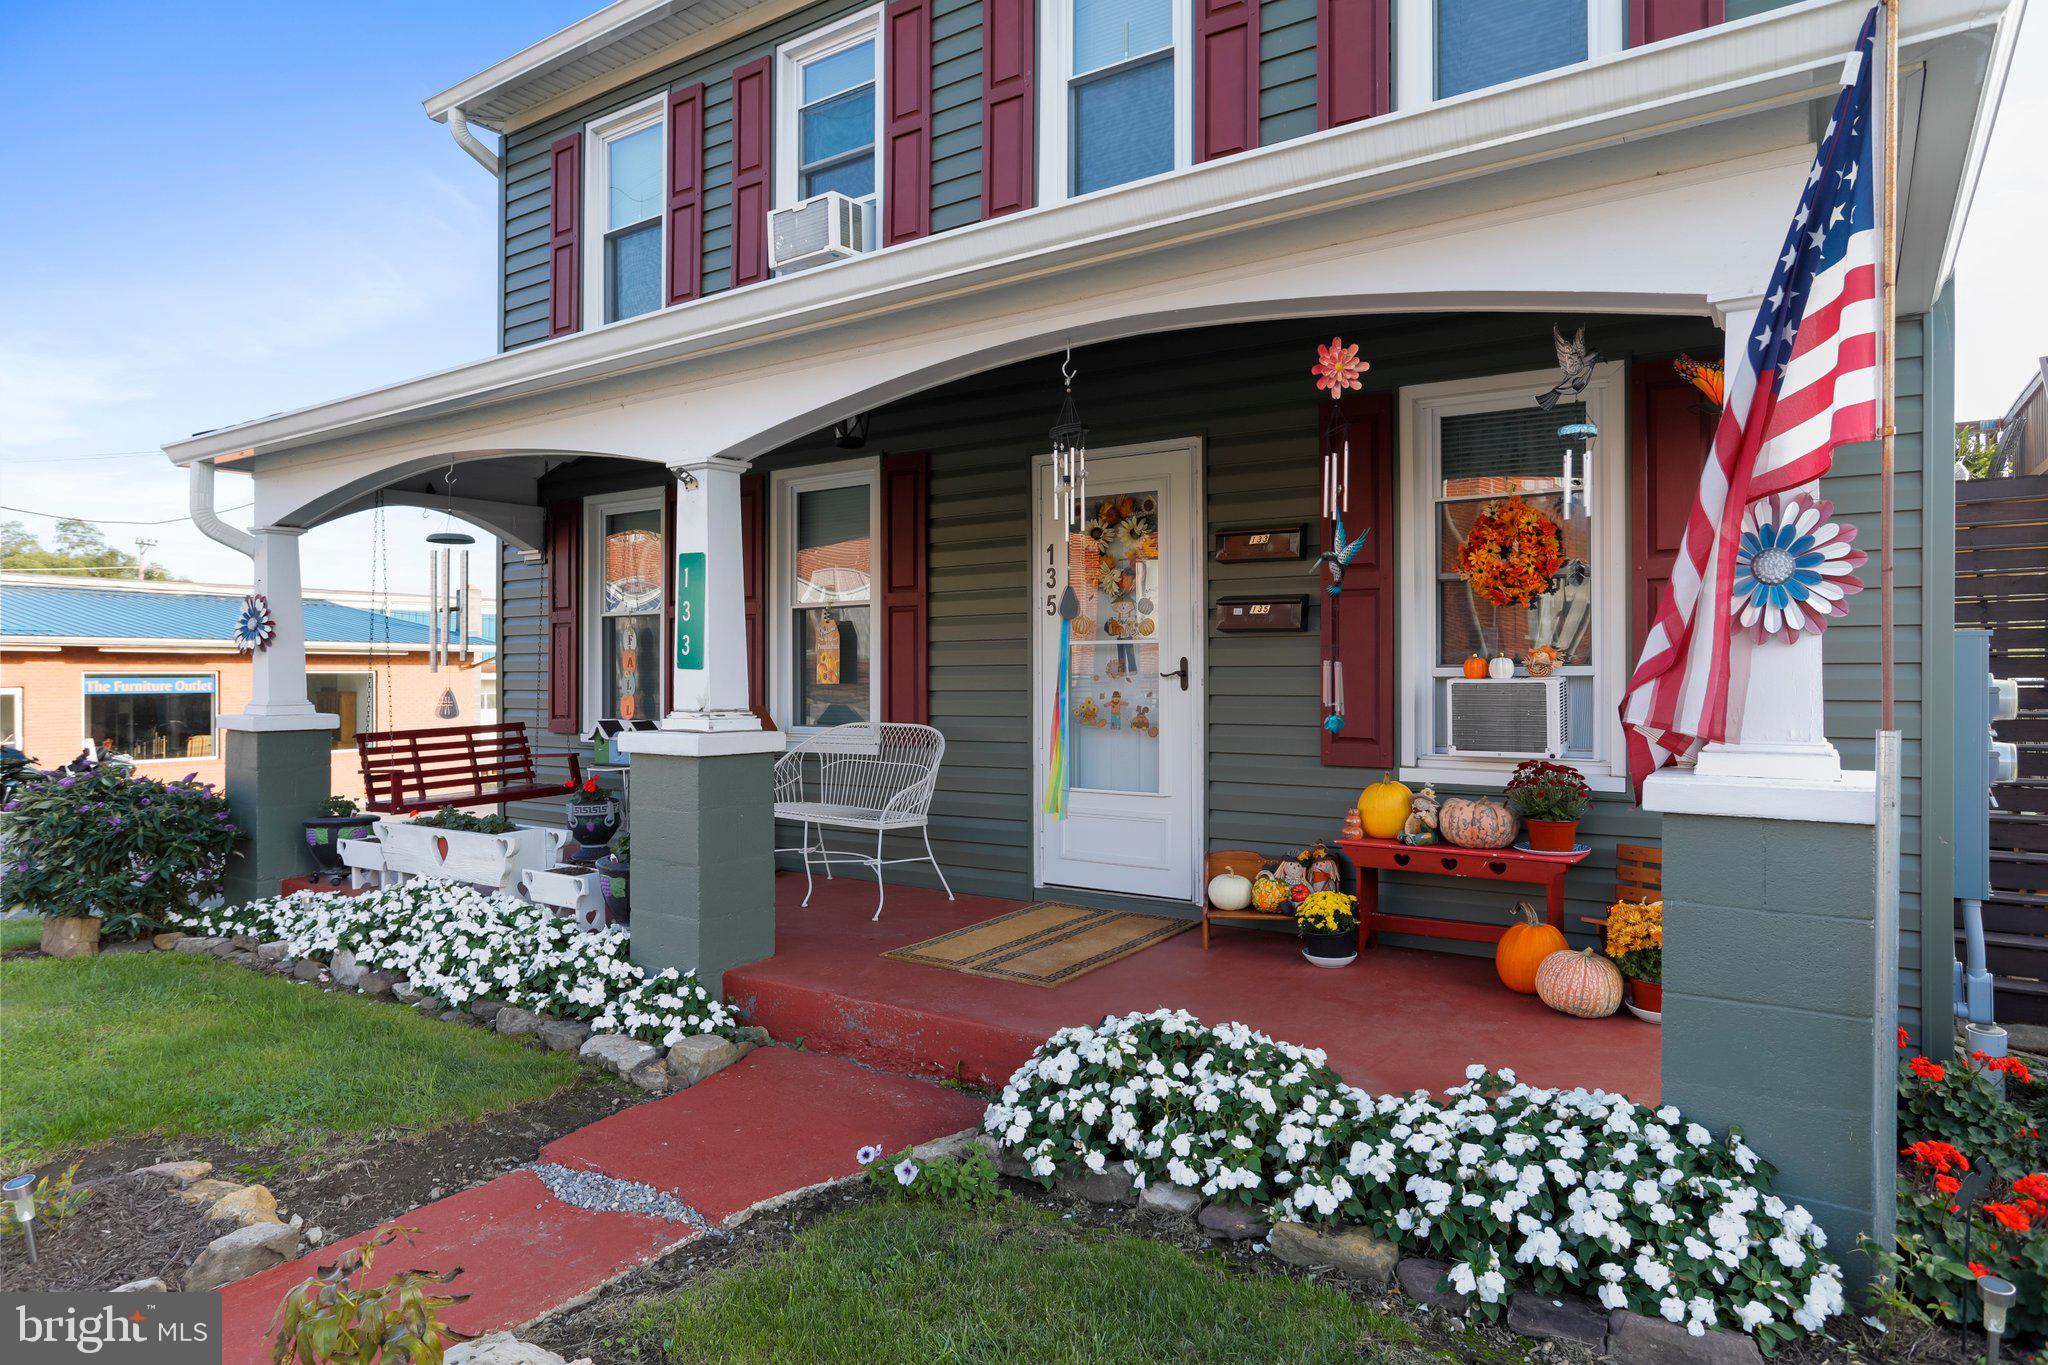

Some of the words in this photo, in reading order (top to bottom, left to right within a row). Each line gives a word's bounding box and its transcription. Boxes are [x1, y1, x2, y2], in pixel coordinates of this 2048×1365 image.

[1250, 535, 1270, 544] 133
[1046, 543, 1057, 616] 135
[681, 567, 691, 656] 133
[1250, 605, 1270, 613] 135
[86, 680, 110, 692] The
[114, 681, 173, 692] Furniture
[175, 680, 213, 691] Outlet
[625, 634, 634, 716] FALL
